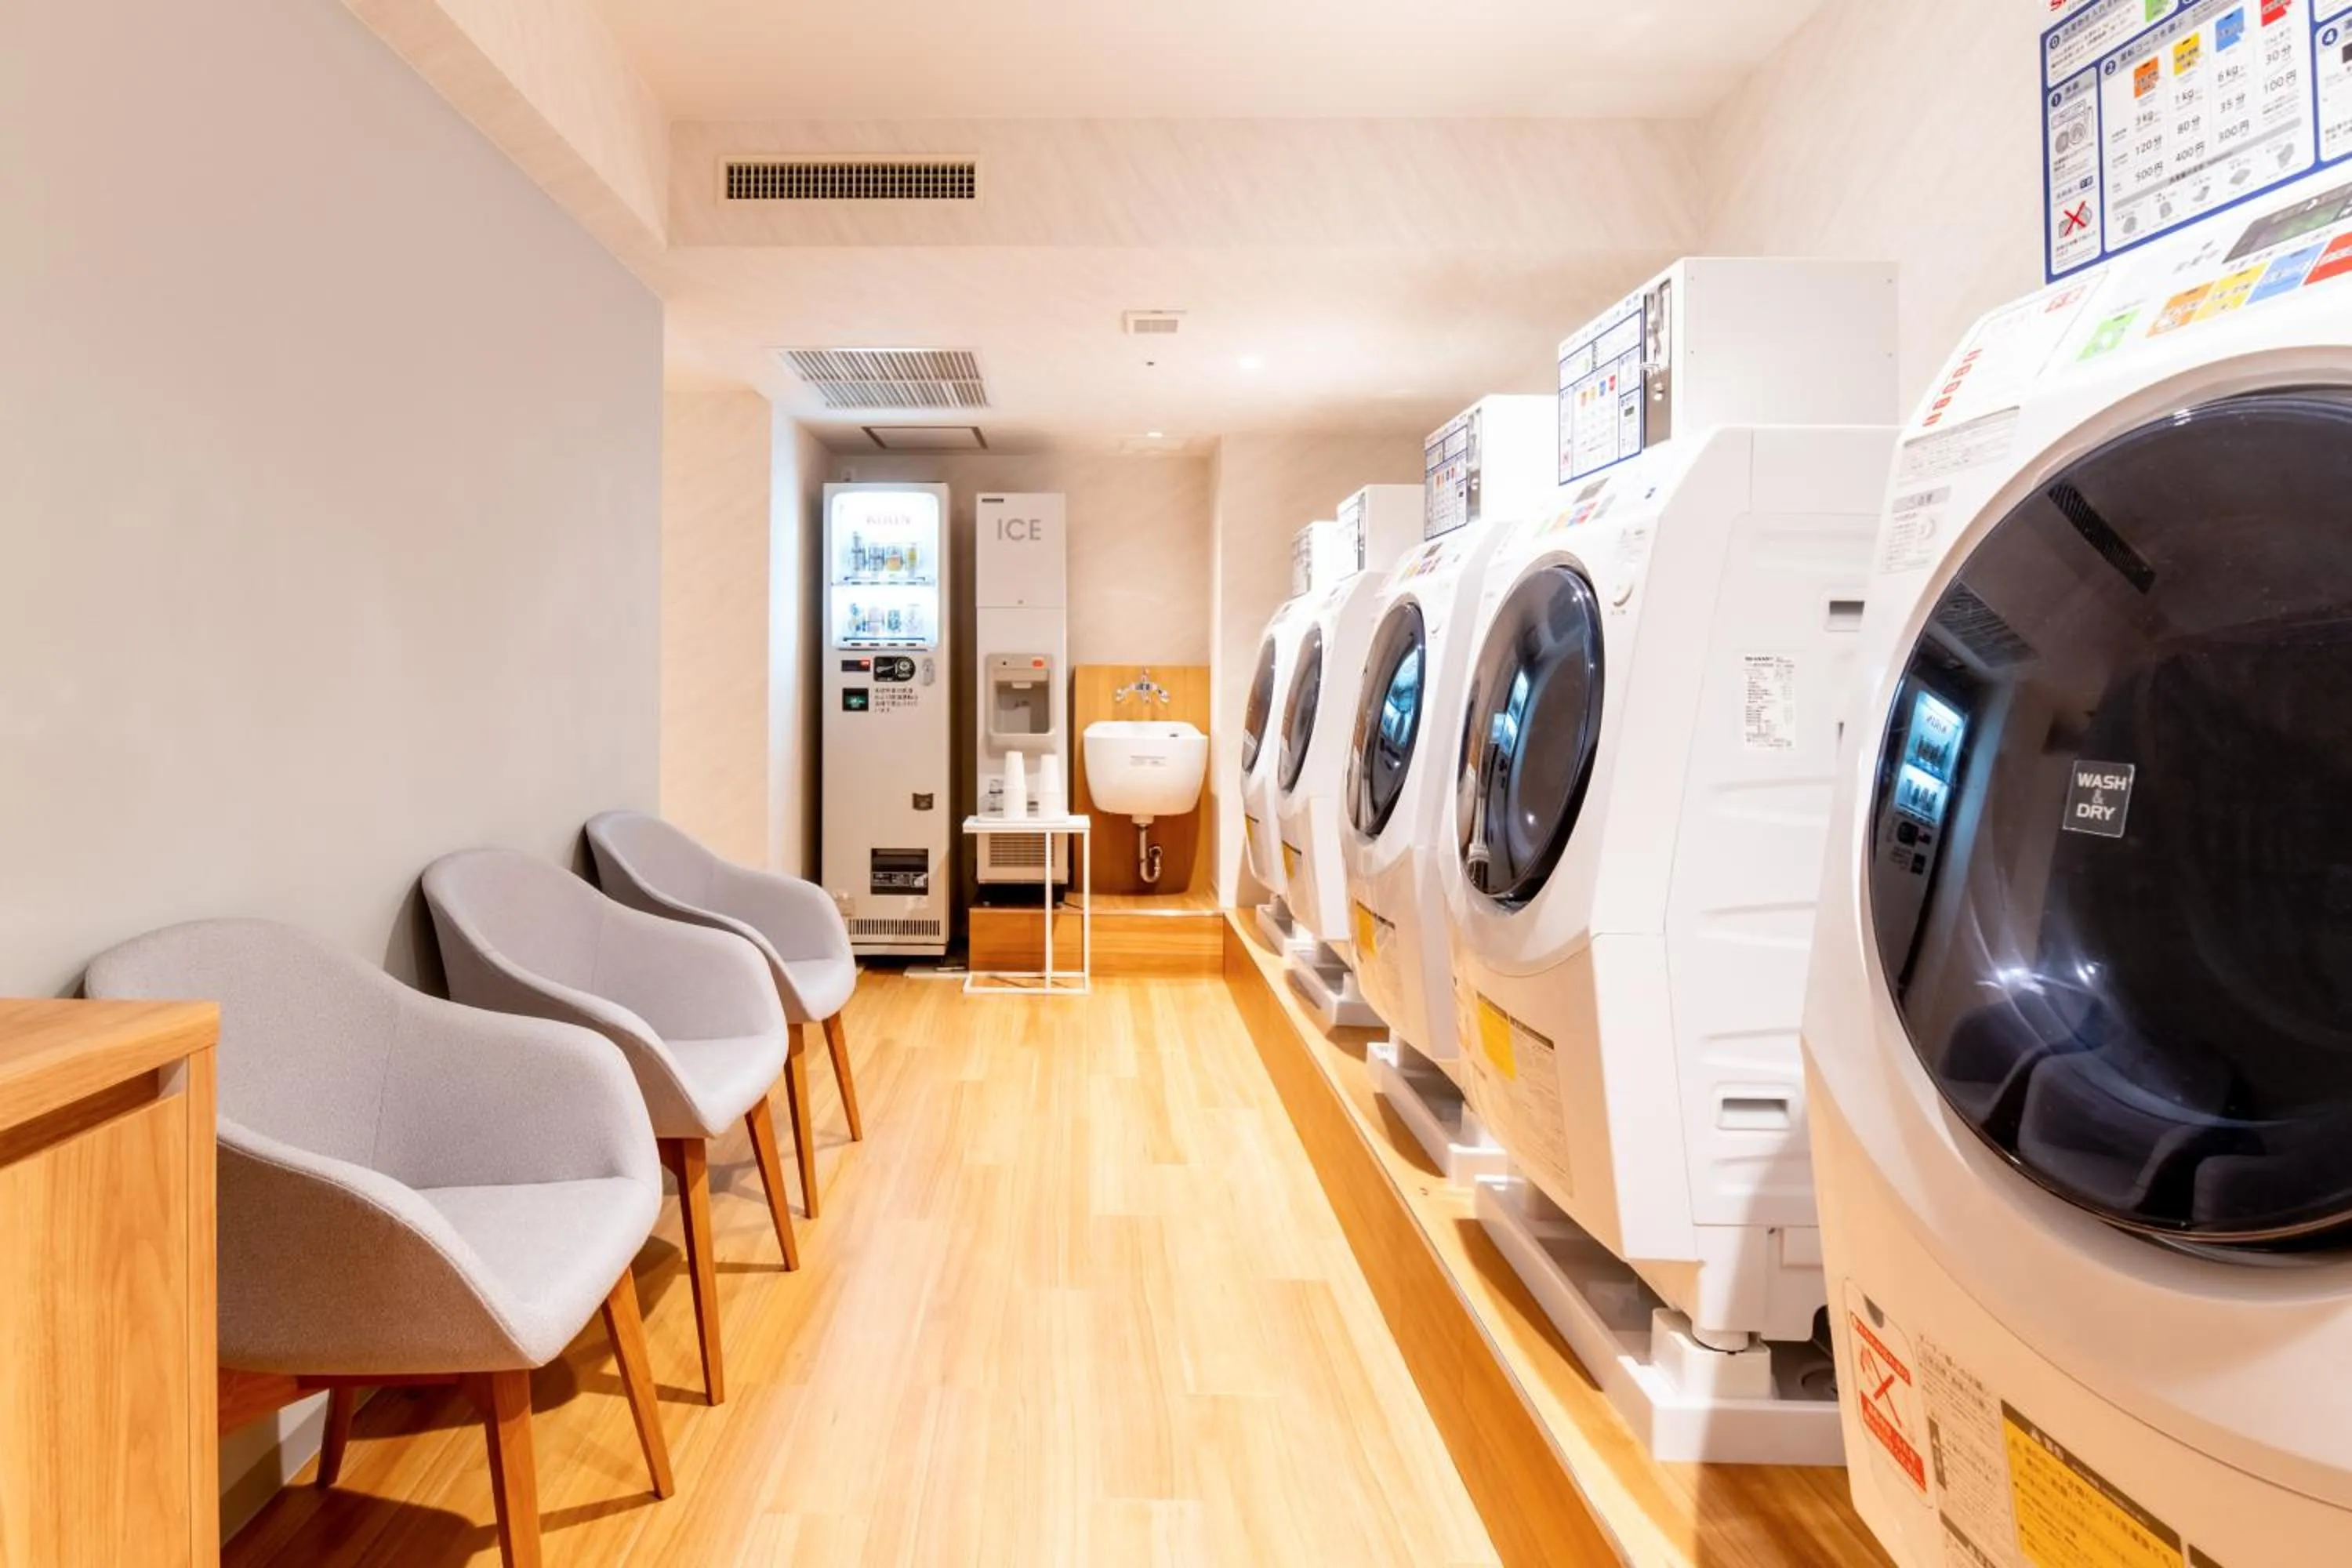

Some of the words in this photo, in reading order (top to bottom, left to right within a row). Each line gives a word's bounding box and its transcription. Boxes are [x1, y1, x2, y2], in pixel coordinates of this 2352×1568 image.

[997, 517, 1042, 541] ICE
[2078, 772, 2127, 790] WASH
[2092, 789, 2103, 804] &
[2076, 803, 2116, 821] DRY
